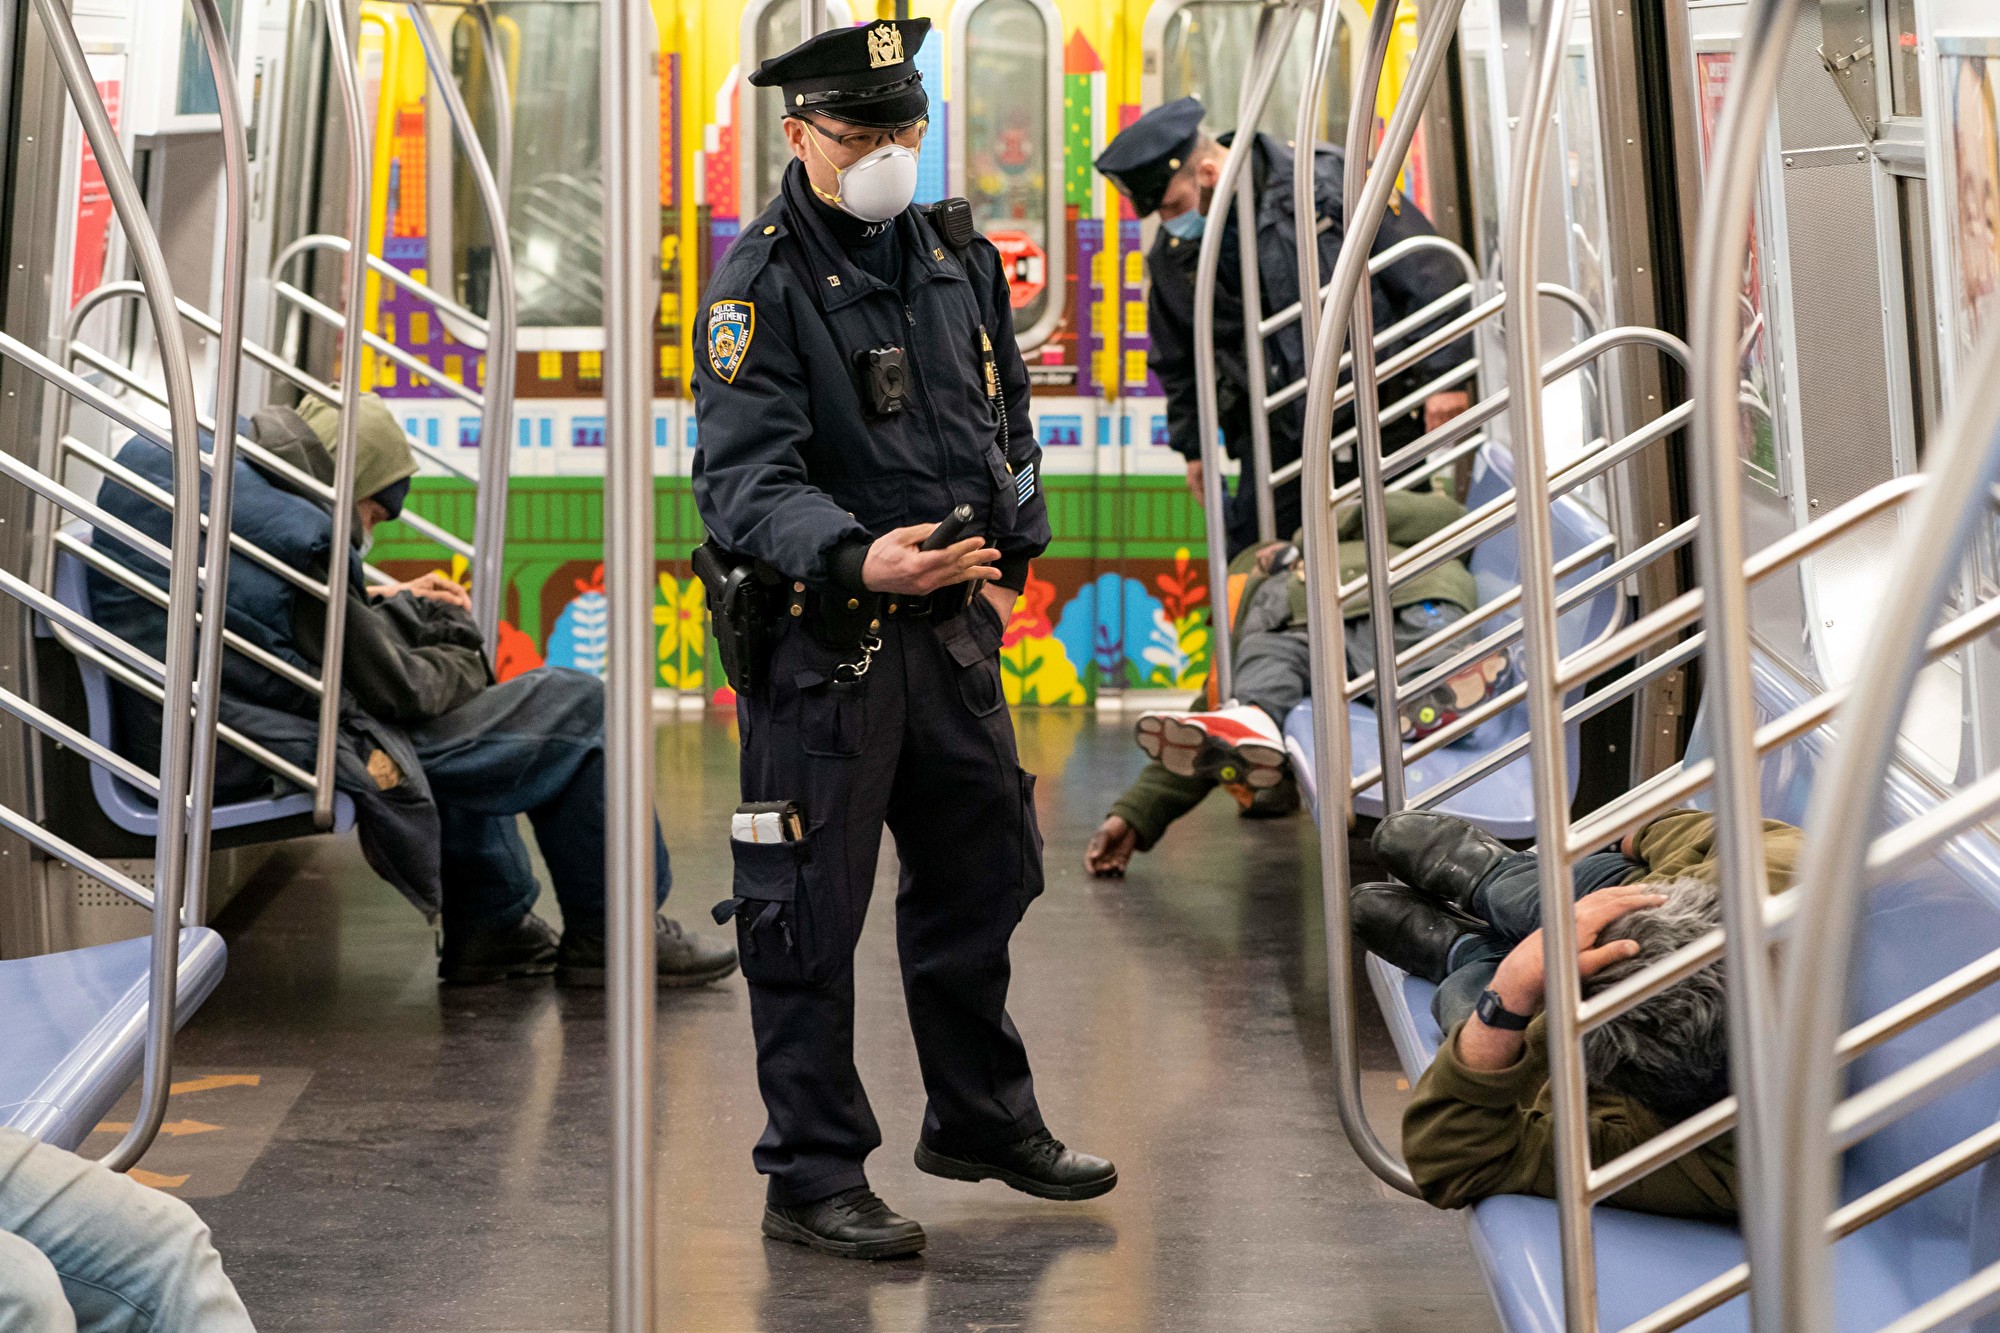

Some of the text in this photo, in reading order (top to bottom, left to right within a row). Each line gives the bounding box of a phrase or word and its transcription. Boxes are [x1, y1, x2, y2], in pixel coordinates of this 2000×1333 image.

[713, 304, 735, 315] POLICE
[729, 330, 749, 371] NEW YORK
[713, 359, 722, 370] OF
